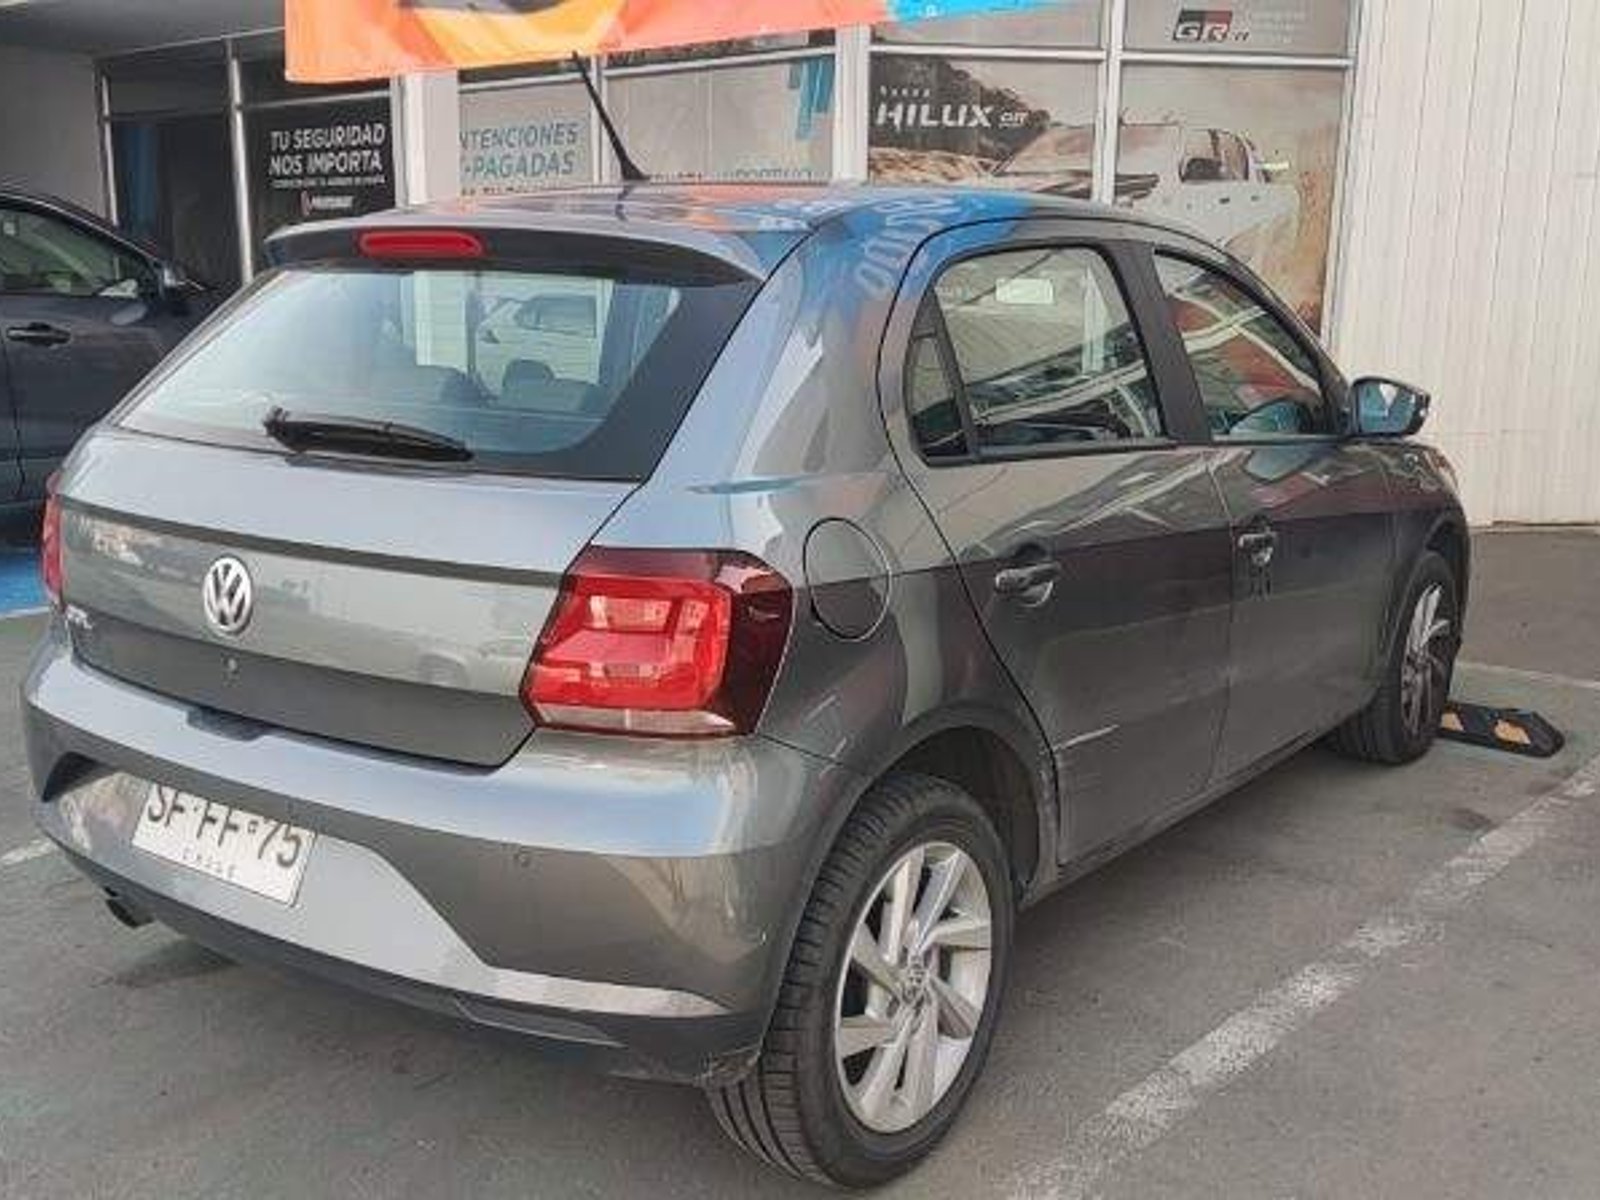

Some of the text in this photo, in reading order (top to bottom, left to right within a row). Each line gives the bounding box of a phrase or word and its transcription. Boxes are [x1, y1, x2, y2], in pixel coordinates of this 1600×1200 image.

[876, 103, 993, 129] HILUX
[270, 123, 386, 150] TU SEGURIDAD
[269, 150, 384, 175] NOS IMPORTA
